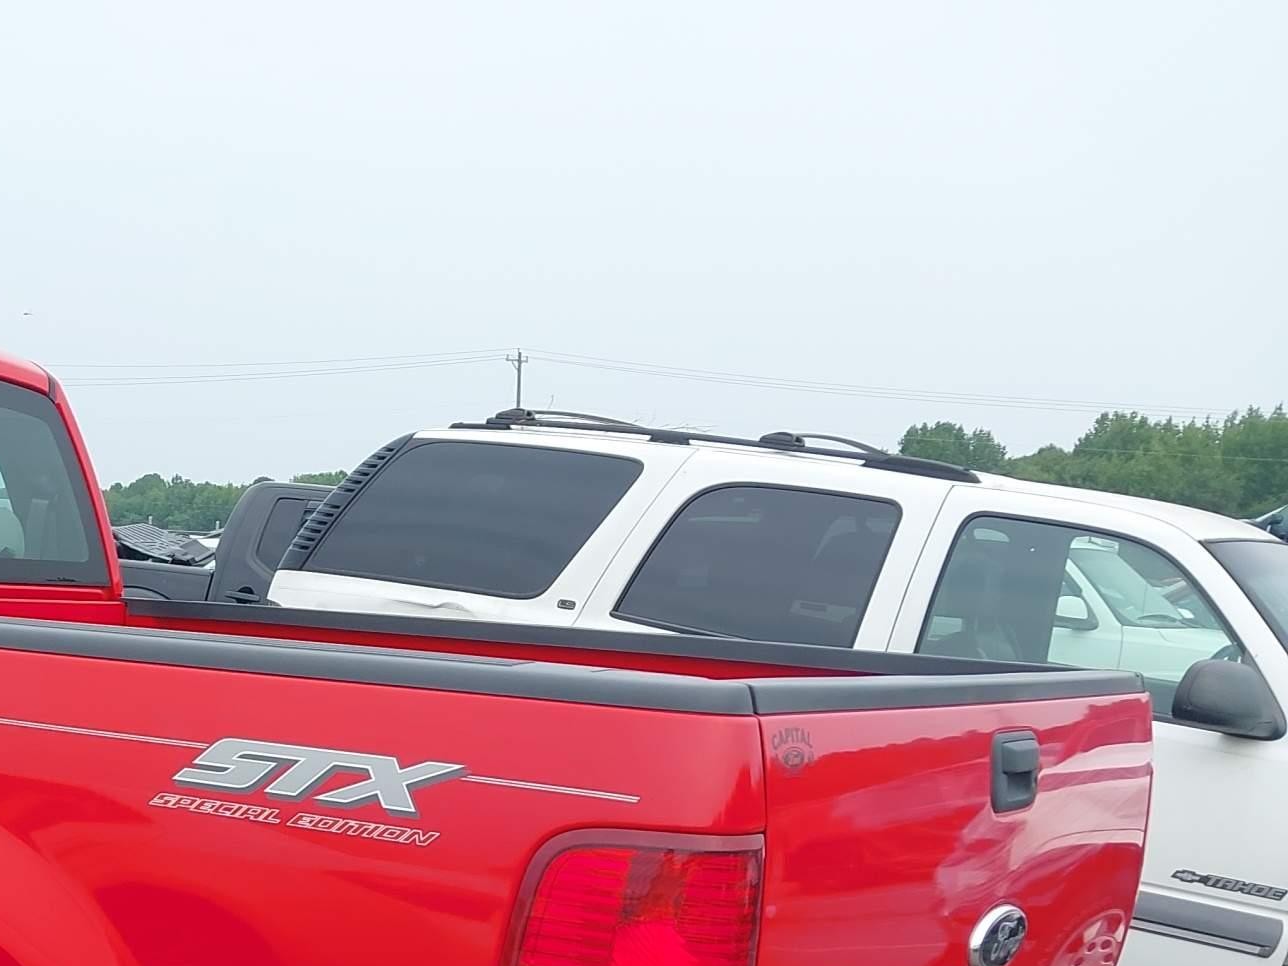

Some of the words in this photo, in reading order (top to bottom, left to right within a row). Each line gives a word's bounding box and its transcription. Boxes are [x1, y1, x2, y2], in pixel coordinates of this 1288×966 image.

[772, 727, 813, 750] CAPITAL
[172, 738, 468, 817] STX
[149, 792, 281, 823] SPECIAL
[287, 813, 440, 847] EDITION
[1205, 874, 1288, 901] TAHOE
